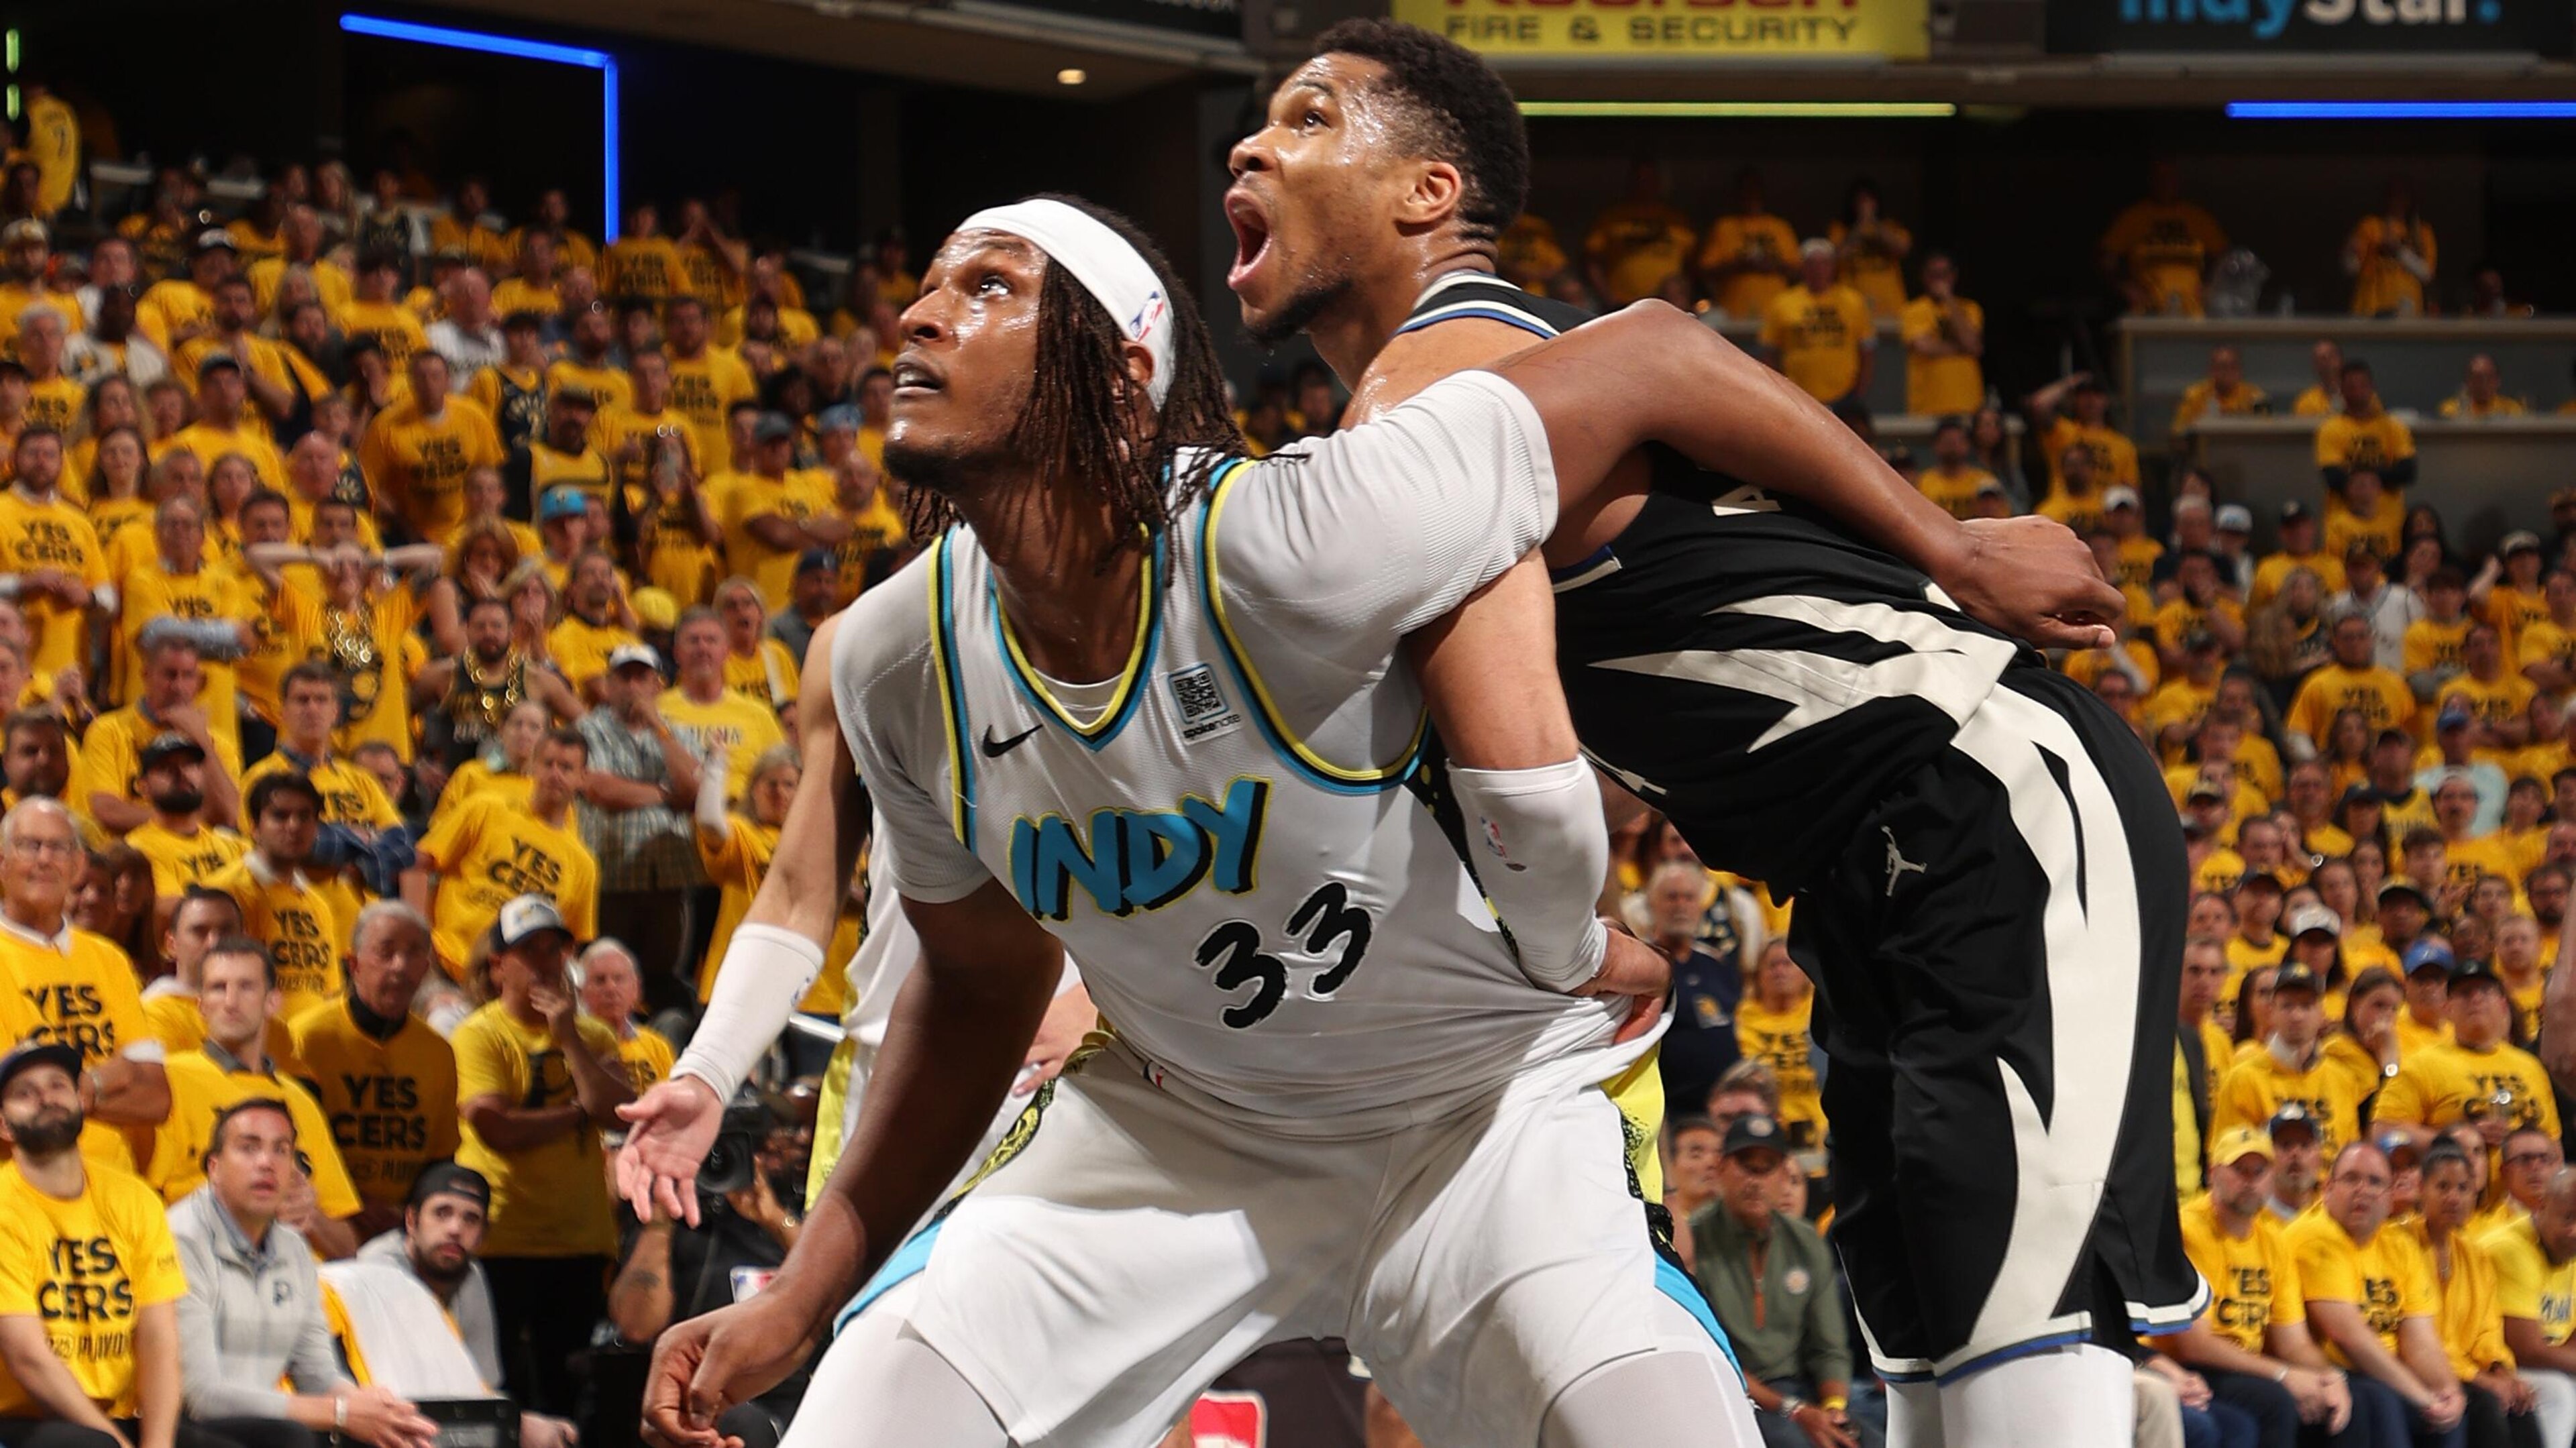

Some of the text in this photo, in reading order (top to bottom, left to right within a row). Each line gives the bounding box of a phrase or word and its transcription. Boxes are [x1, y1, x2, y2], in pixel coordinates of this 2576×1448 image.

[1445, 15, 1857, 42] FIRE & SECURITY
[510, 835, 561, 885] YES
[1009, 774, 1273, 924] INDY
[271, 909, 319, 937] YES
[272, 940, 330, 968] CERS
[1193, 880, 1372, 1029] 33
[22, 984, 102, 1017] YES
[341, 1073, 419, 1110] YES
[332, 1111, 426, 1150] CERS
[38, 1279, 133, 1321] CERS
